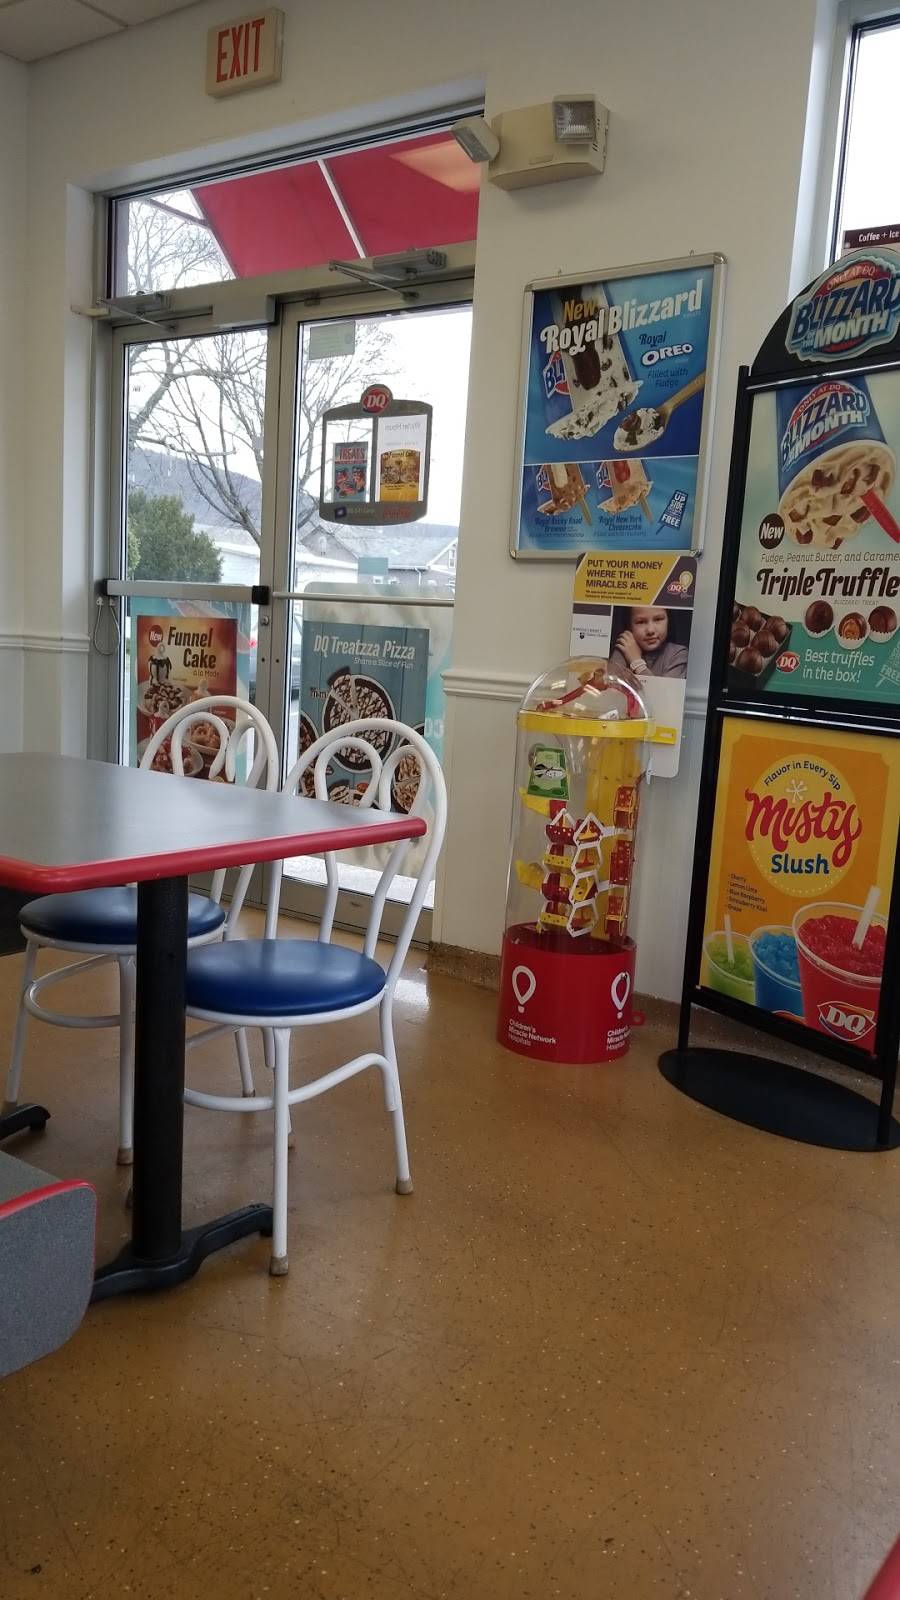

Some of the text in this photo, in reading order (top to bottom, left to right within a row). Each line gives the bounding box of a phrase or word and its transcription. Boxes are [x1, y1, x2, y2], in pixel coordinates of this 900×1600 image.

[216, 17, 265, 83] EXIT
[858, 232, 880, 242] Coffee
[827, 271, 847, 290] ONLY
[861, 265, 876, 276] DQ
[540, 279, 704, 356] Royal Blizzard
[563, 299, 597, 322] New
[814, 309, 889, 348] MONTH
[639, 331, 667, 347] Royal
[642, 343, 693, 366] OREO
[648, 367, 689, 379] Filled with
[655, 380, 680, 389] Fudge
[366, 393, 386, 409] DQ
[799, 391, 817, 412] ONLY
[781, 392, 867, 463] BLIZZARD
[793, 410, 864, 460] MONTH
[674, 493, 686, 502] UP
[661, 514, 681, 527] FREE
[760, 525, 785, 540] New
[587, 560, 663, 570] PUT YOUR MONEY
[761, 553, 785, 565] Fudge,
[786, 552, 813, 563] Peanut
[815, 552, 842, 563] Butter,
[844, 552, 862, 562] and
[586, 570, 635, 579] WHERE THE
[757, 567, 900, 601] Triple Truffle
[585, 580, 649, 591] MIRACLES ARE.
[150, 631, 163, 641] New
[168, 626, 213, 648] Funnel
[313, 634, 416, 660] DQ Treatzza Pizza
[183, 648, 217, 669] Cake
[780, 656, 797, 669] DQ
[804, 649, 828, 663] Best
[830, 649, 875, 667] truffles
[803, 667, 862, 683] in the box!
[763, 760, 841, 791] Flavor in Every Sip
[744, 787, 863, 868] Misty
[771, 853, 830, 874] Slush
[826, 1005, 866, 1036] DQ
[528, 1033, 556, 1045] Network
